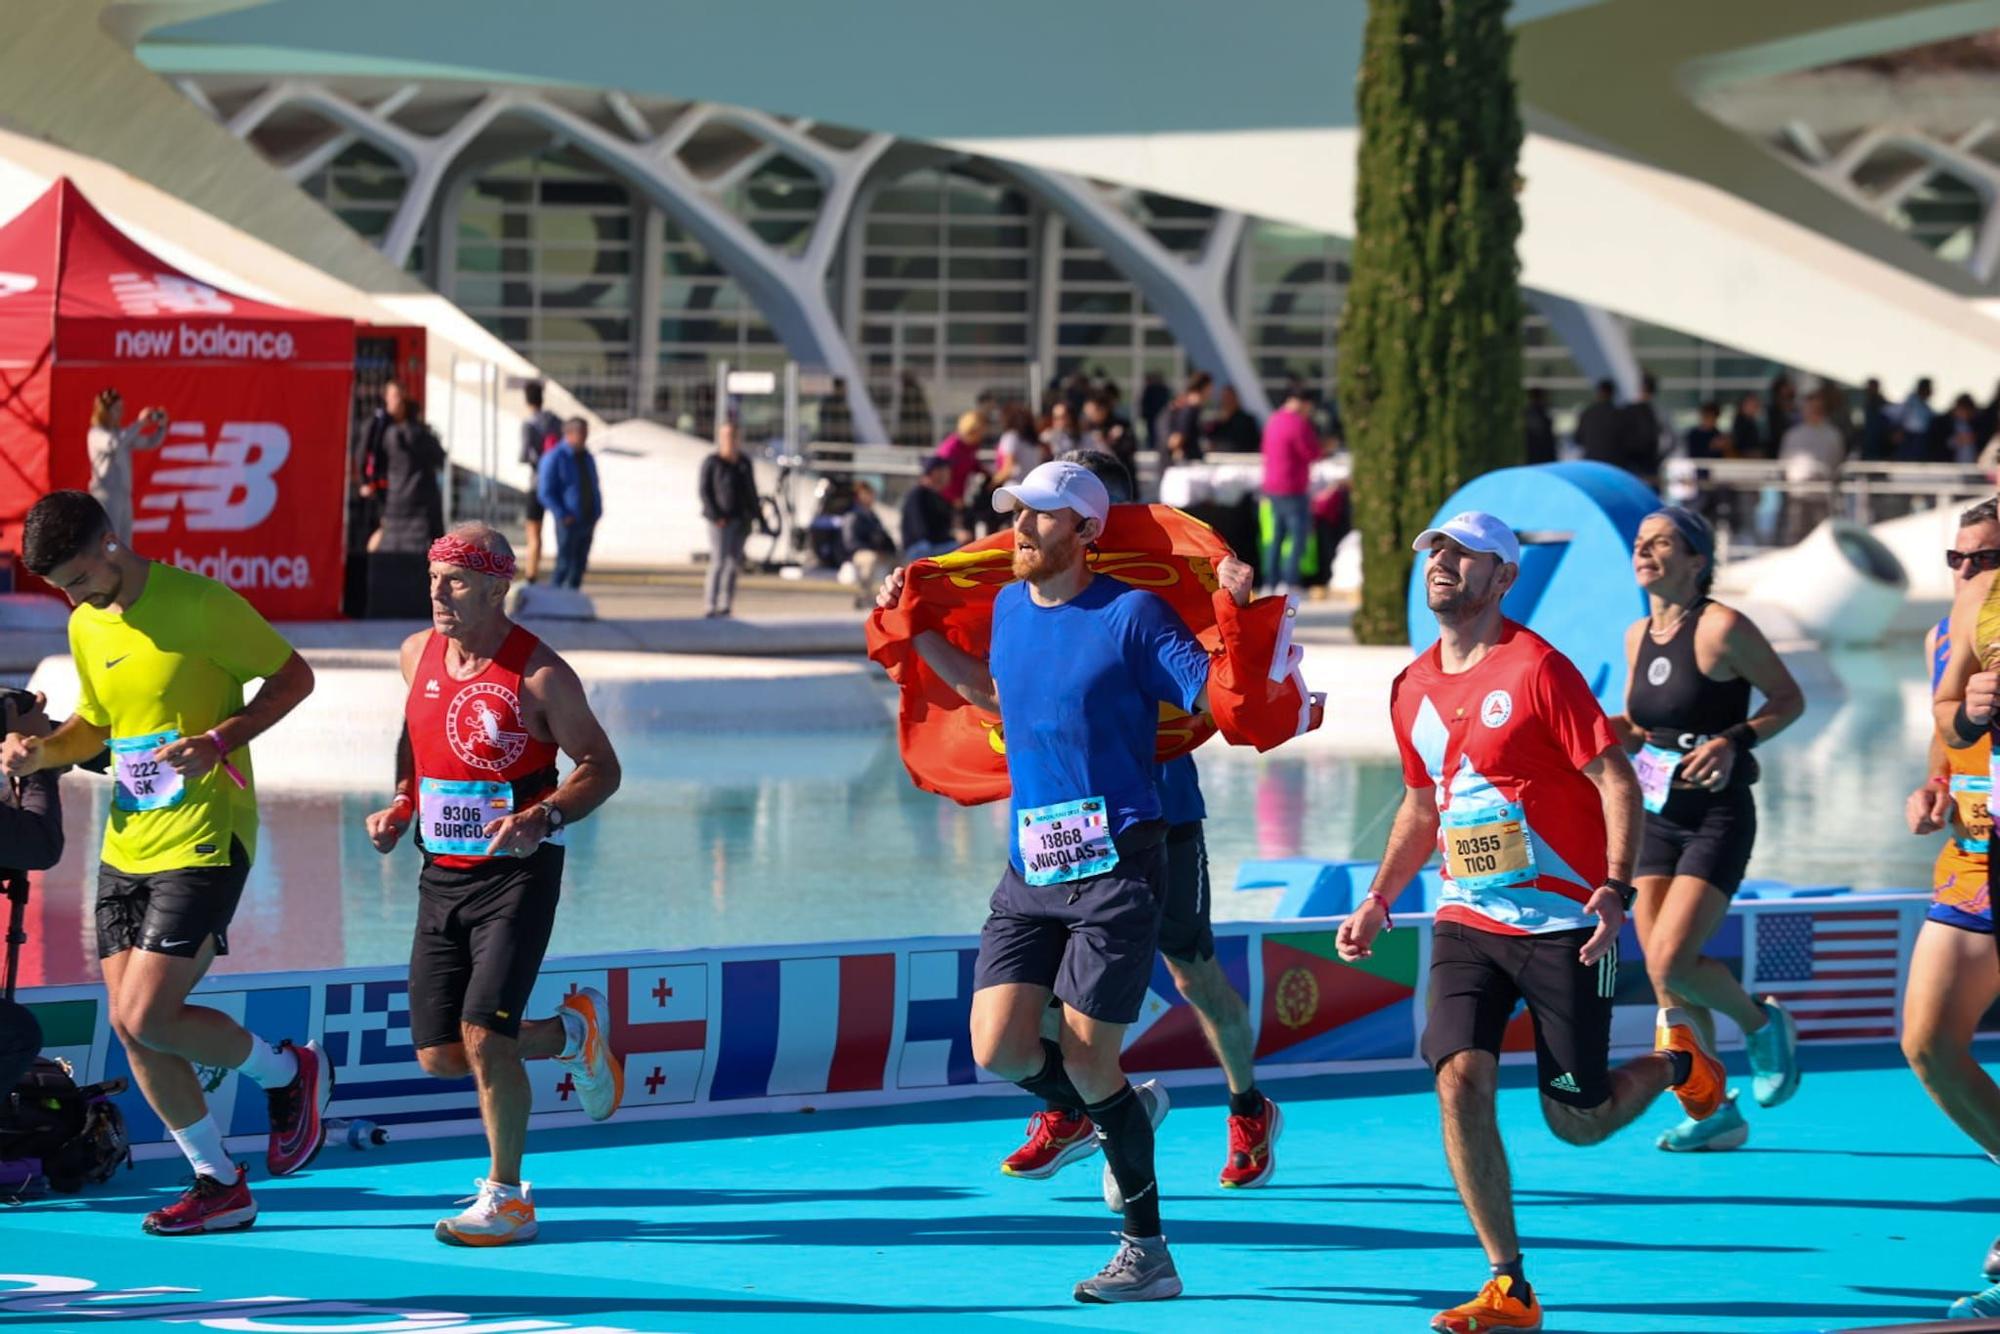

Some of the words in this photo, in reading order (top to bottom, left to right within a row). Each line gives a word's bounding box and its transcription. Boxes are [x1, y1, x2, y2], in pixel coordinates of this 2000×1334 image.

[115, 329, 174, 357] new
[179, 323, 293, 359] balance
[443, 806, 481, 822] 9306
[1040, 828, 1082, 849] 13868
[1456, 835, 1501, 855] 20355
[1036, 843, 1096, 869] NICOLAS
[1464, 855, 1496, 873] TICO
